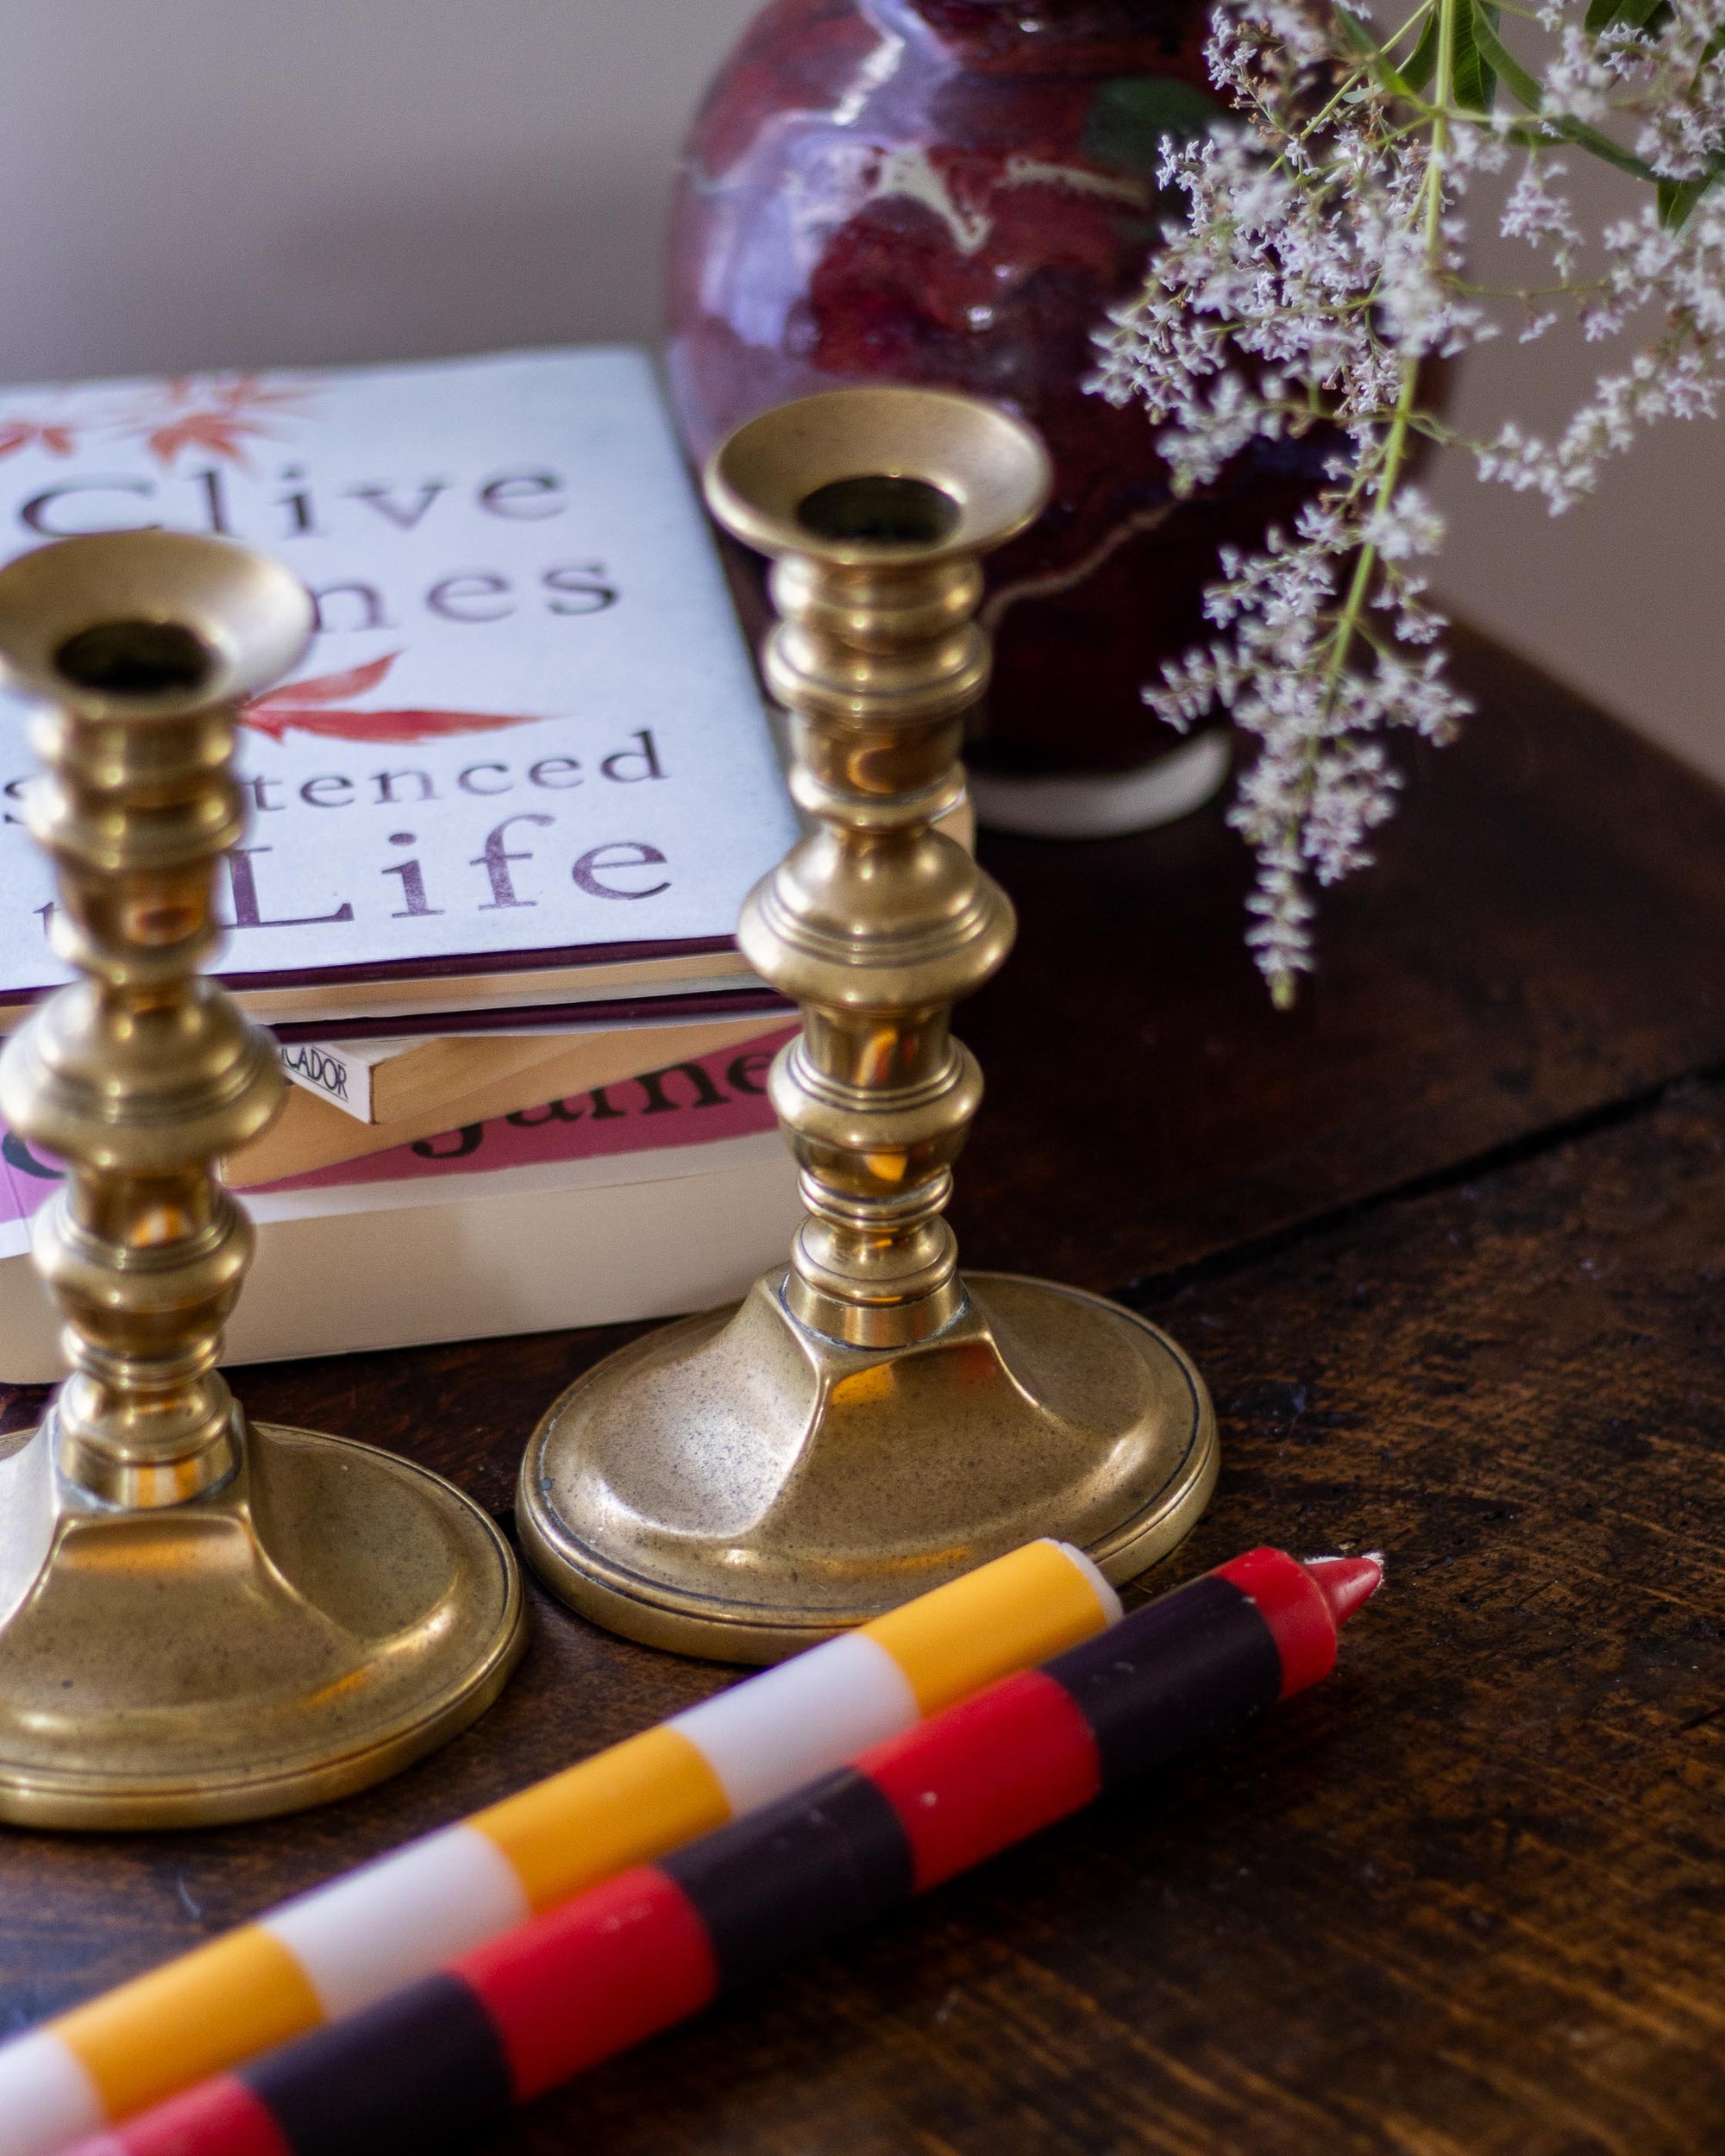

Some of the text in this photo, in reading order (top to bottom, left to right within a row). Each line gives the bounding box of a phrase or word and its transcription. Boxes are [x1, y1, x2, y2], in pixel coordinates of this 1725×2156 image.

[21, 466, 569, 538] Clive
[3, 730, 669, 825] Stenced
[222, 814, 673, 930] Life
[281, 1046, 348, 1100] CADOR
